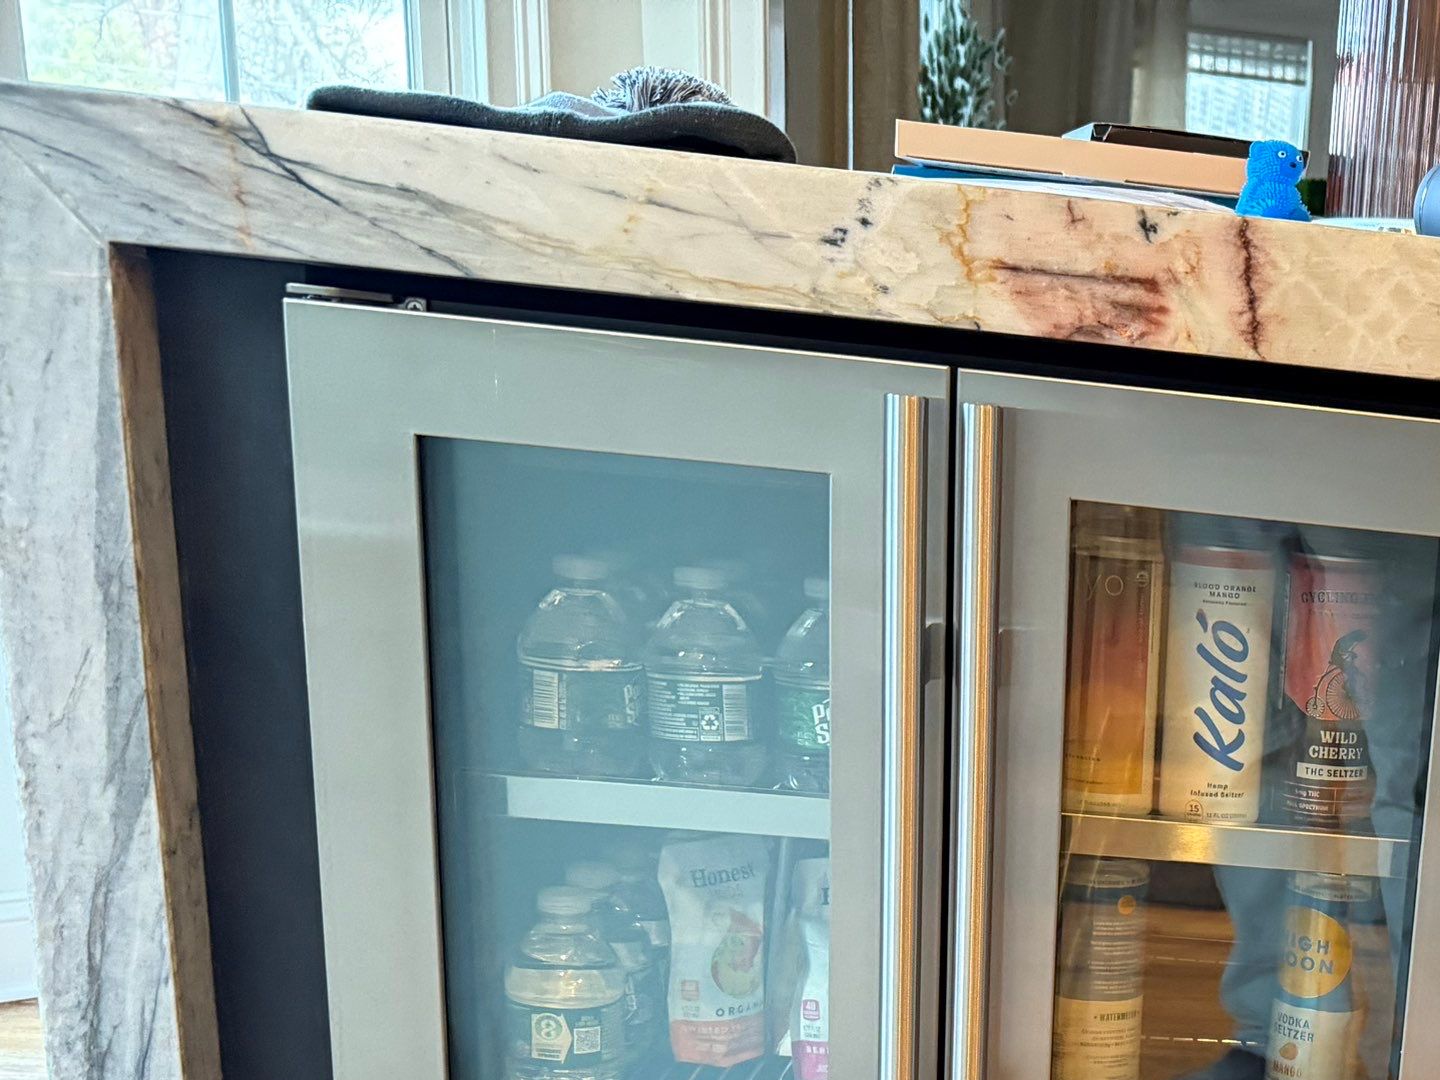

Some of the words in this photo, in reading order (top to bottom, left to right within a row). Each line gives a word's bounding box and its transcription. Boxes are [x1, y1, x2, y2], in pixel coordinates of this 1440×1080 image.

[1209, 591, 1241, 600] MANGO
[1223, 584, 1257, 593] ORANGE
[1193, 608, 1250, 772] Kaló
[1320, 730, 1358, 745] WILD
[1308, 745, 1364, 760] CHERRY
[1305, 766, 1324, 776] THC
[1326, 769, 1366, 779] SELTZER
[1190, 789, 1219, 798] Infused
[1207, 782, 1229, 790] Hemp
[1284, 950, 1334, 975] OON
[1277, 1012, 1310, 1030] VODKA
[1274, 1022, 1315, 1042] SELTZER
[1272, 1060, 1303, 1078] MANGO
